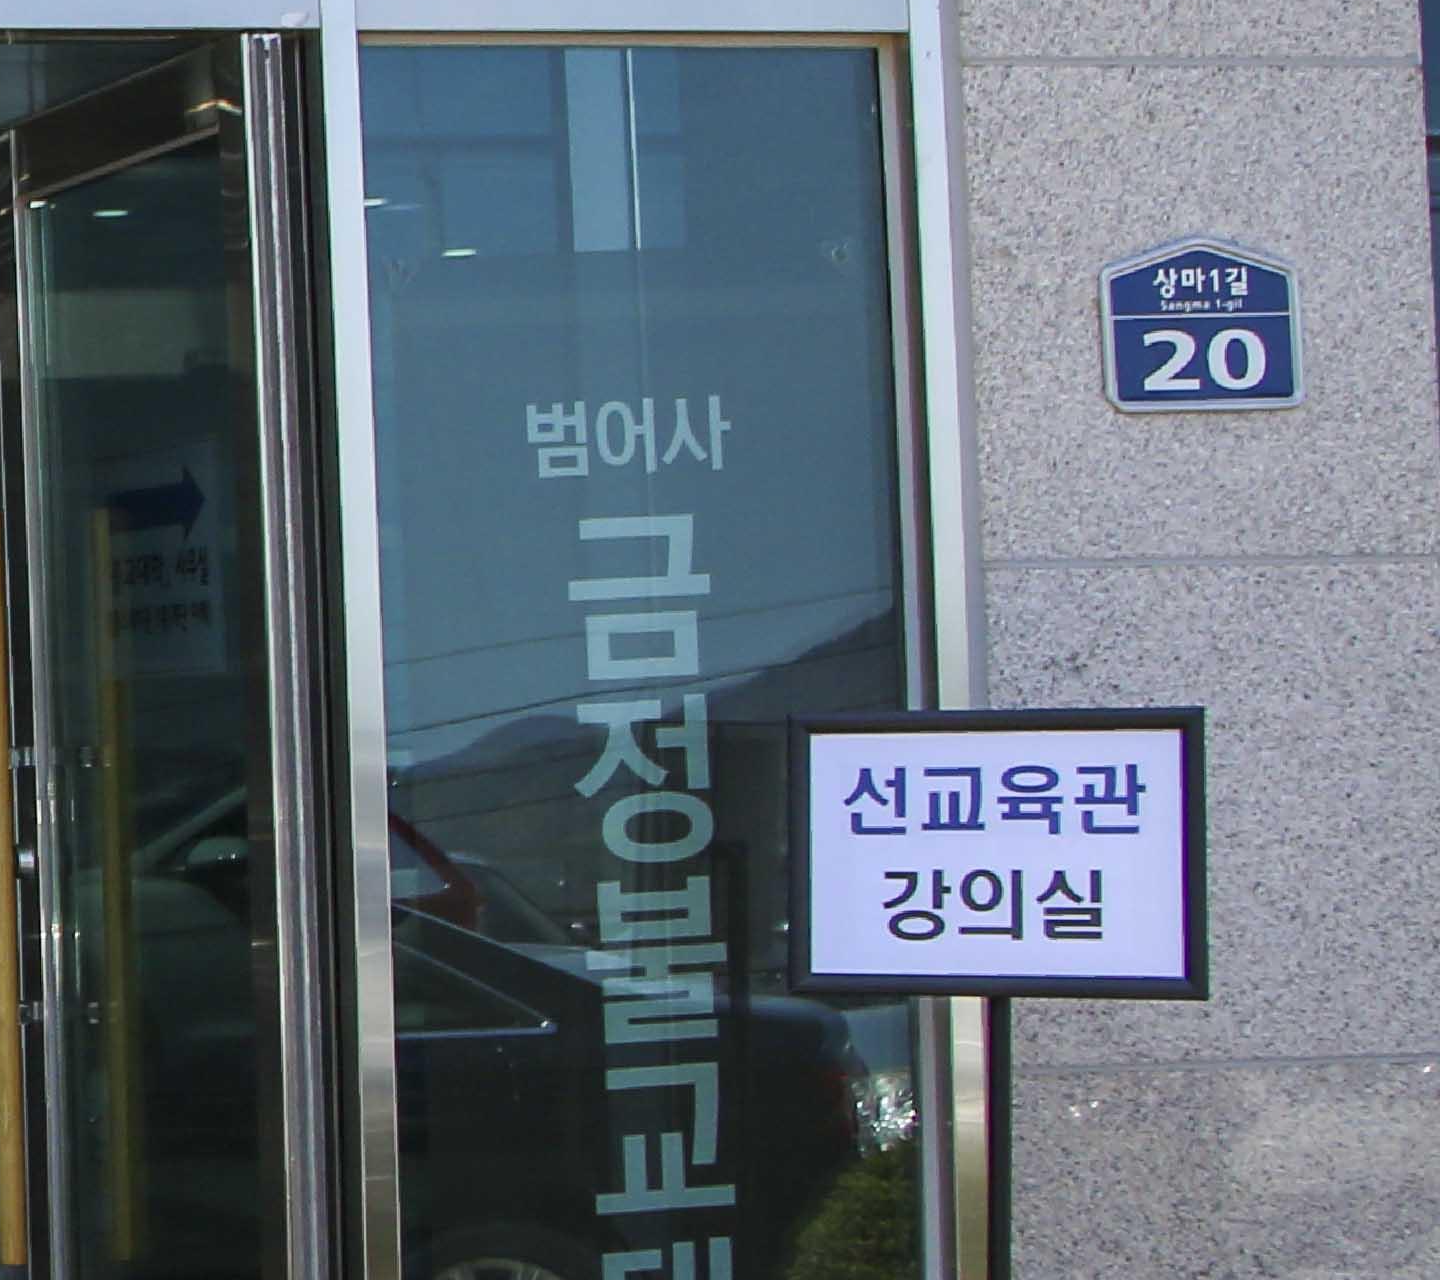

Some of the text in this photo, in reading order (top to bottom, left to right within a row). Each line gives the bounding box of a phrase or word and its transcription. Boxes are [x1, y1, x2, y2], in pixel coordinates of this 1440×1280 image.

[1152, 265, 1248, 299] 상마1길
[1160, 299, 1211, 312] Sangma
[1142, 327, 1267, 392] 20
[525, 394, 732, 479] 범어사
[843, 763, 1147, 835] 선교육관
[882, 868, 1104, 941] 강의실
